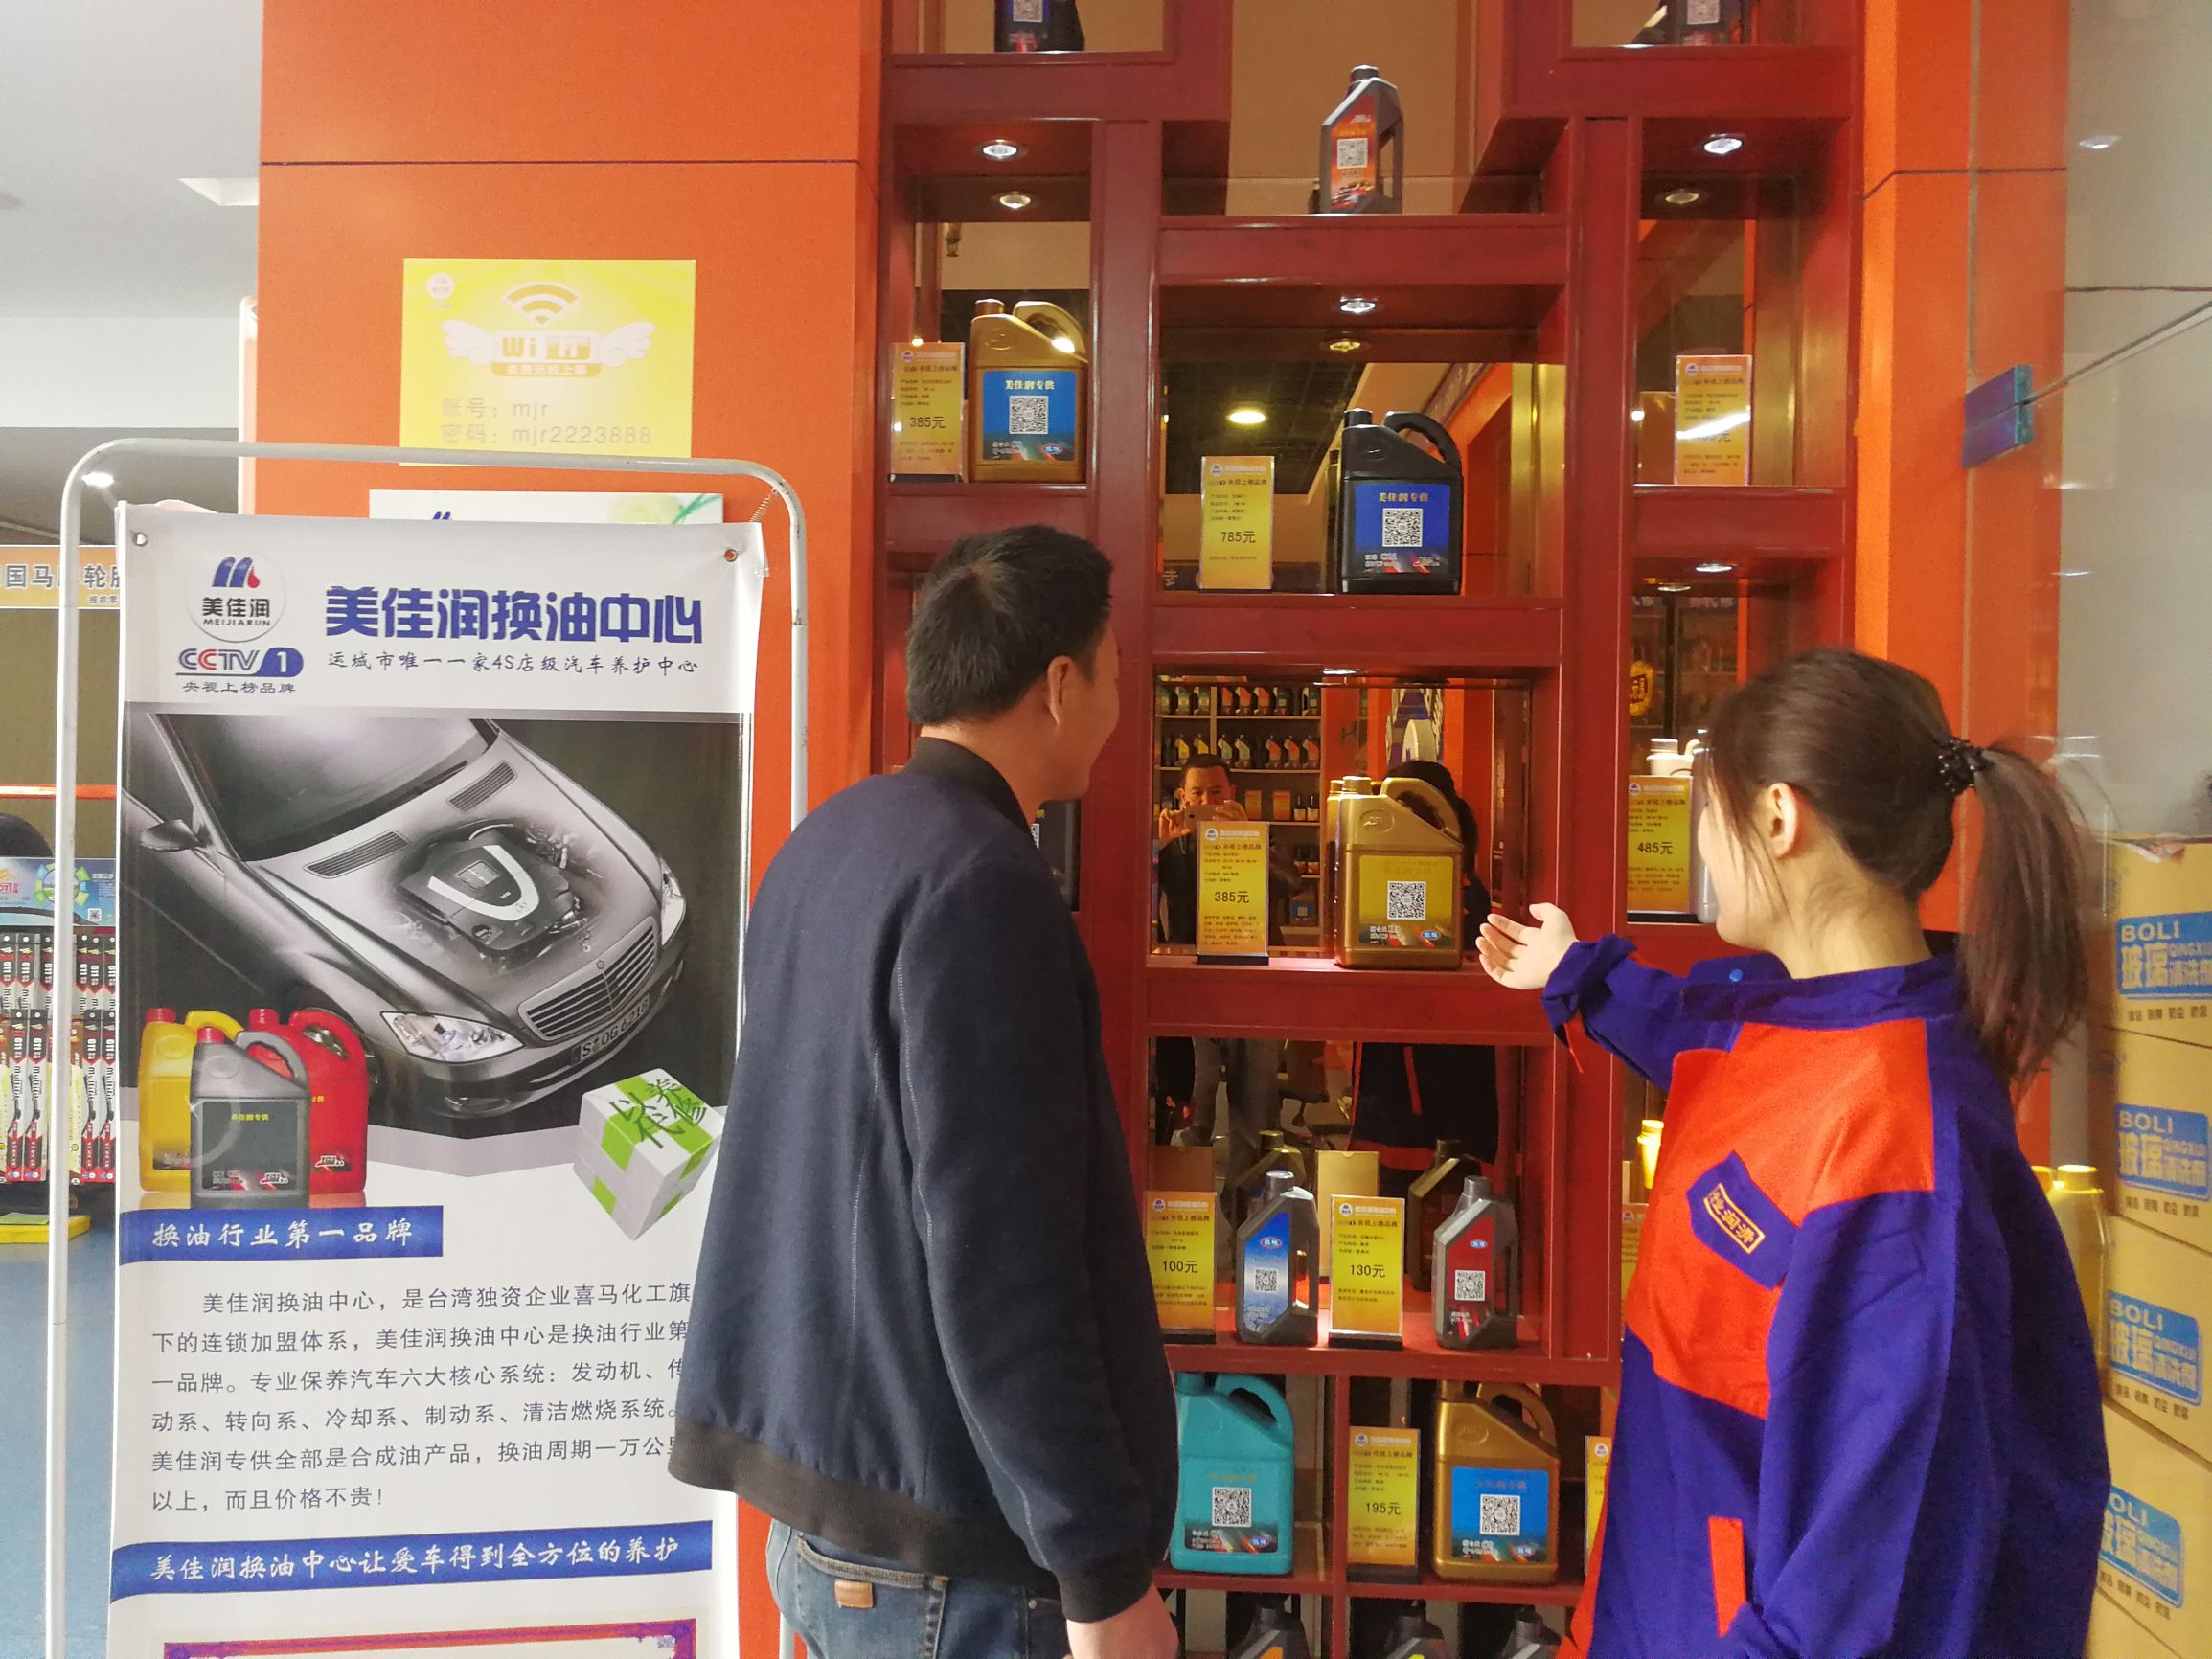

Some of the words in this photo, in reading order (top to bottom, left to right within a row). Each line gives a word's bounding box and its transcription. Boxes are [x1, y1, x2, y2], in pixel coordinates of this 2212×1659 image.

[909, 416, 946, 429] 385元
[1220, 530, 1256, 544] 785元
[202, 597, 270, 618] 美佳润
[326, 585, 703, 644] 美佳润换油中心
[202, 619, 271, 627] MEIJIARUN
[327, 650, 698, 676] 运城市唯一一家4S店级汽车养护中心
[182, 681, 297, 694] 央视上榜品牌
[1636, 841, 1674, 855] 485元
[1214, 890, 1250, 904] 385元
[2120, 920, 2180, 943] BOLI
[2118, 1109, 2174, 1135] BOLI
[152, 1217, 413, 1249] 换油行业第一品牌
[1162, 1260, 1197, 1274] 100元
[1350, 1263, 1386, 1278] 130元
[151, 1436, 676, 1472] 美佳润专供全部是合成油产品，换油周期一万公
[1365, 1502, 1402, 1516] 195元
[2109, 1493, 2150, 1527] OLI
[150, 1536, 679, 1581] 美佳润换油中心让爱车得到全方位的养护
